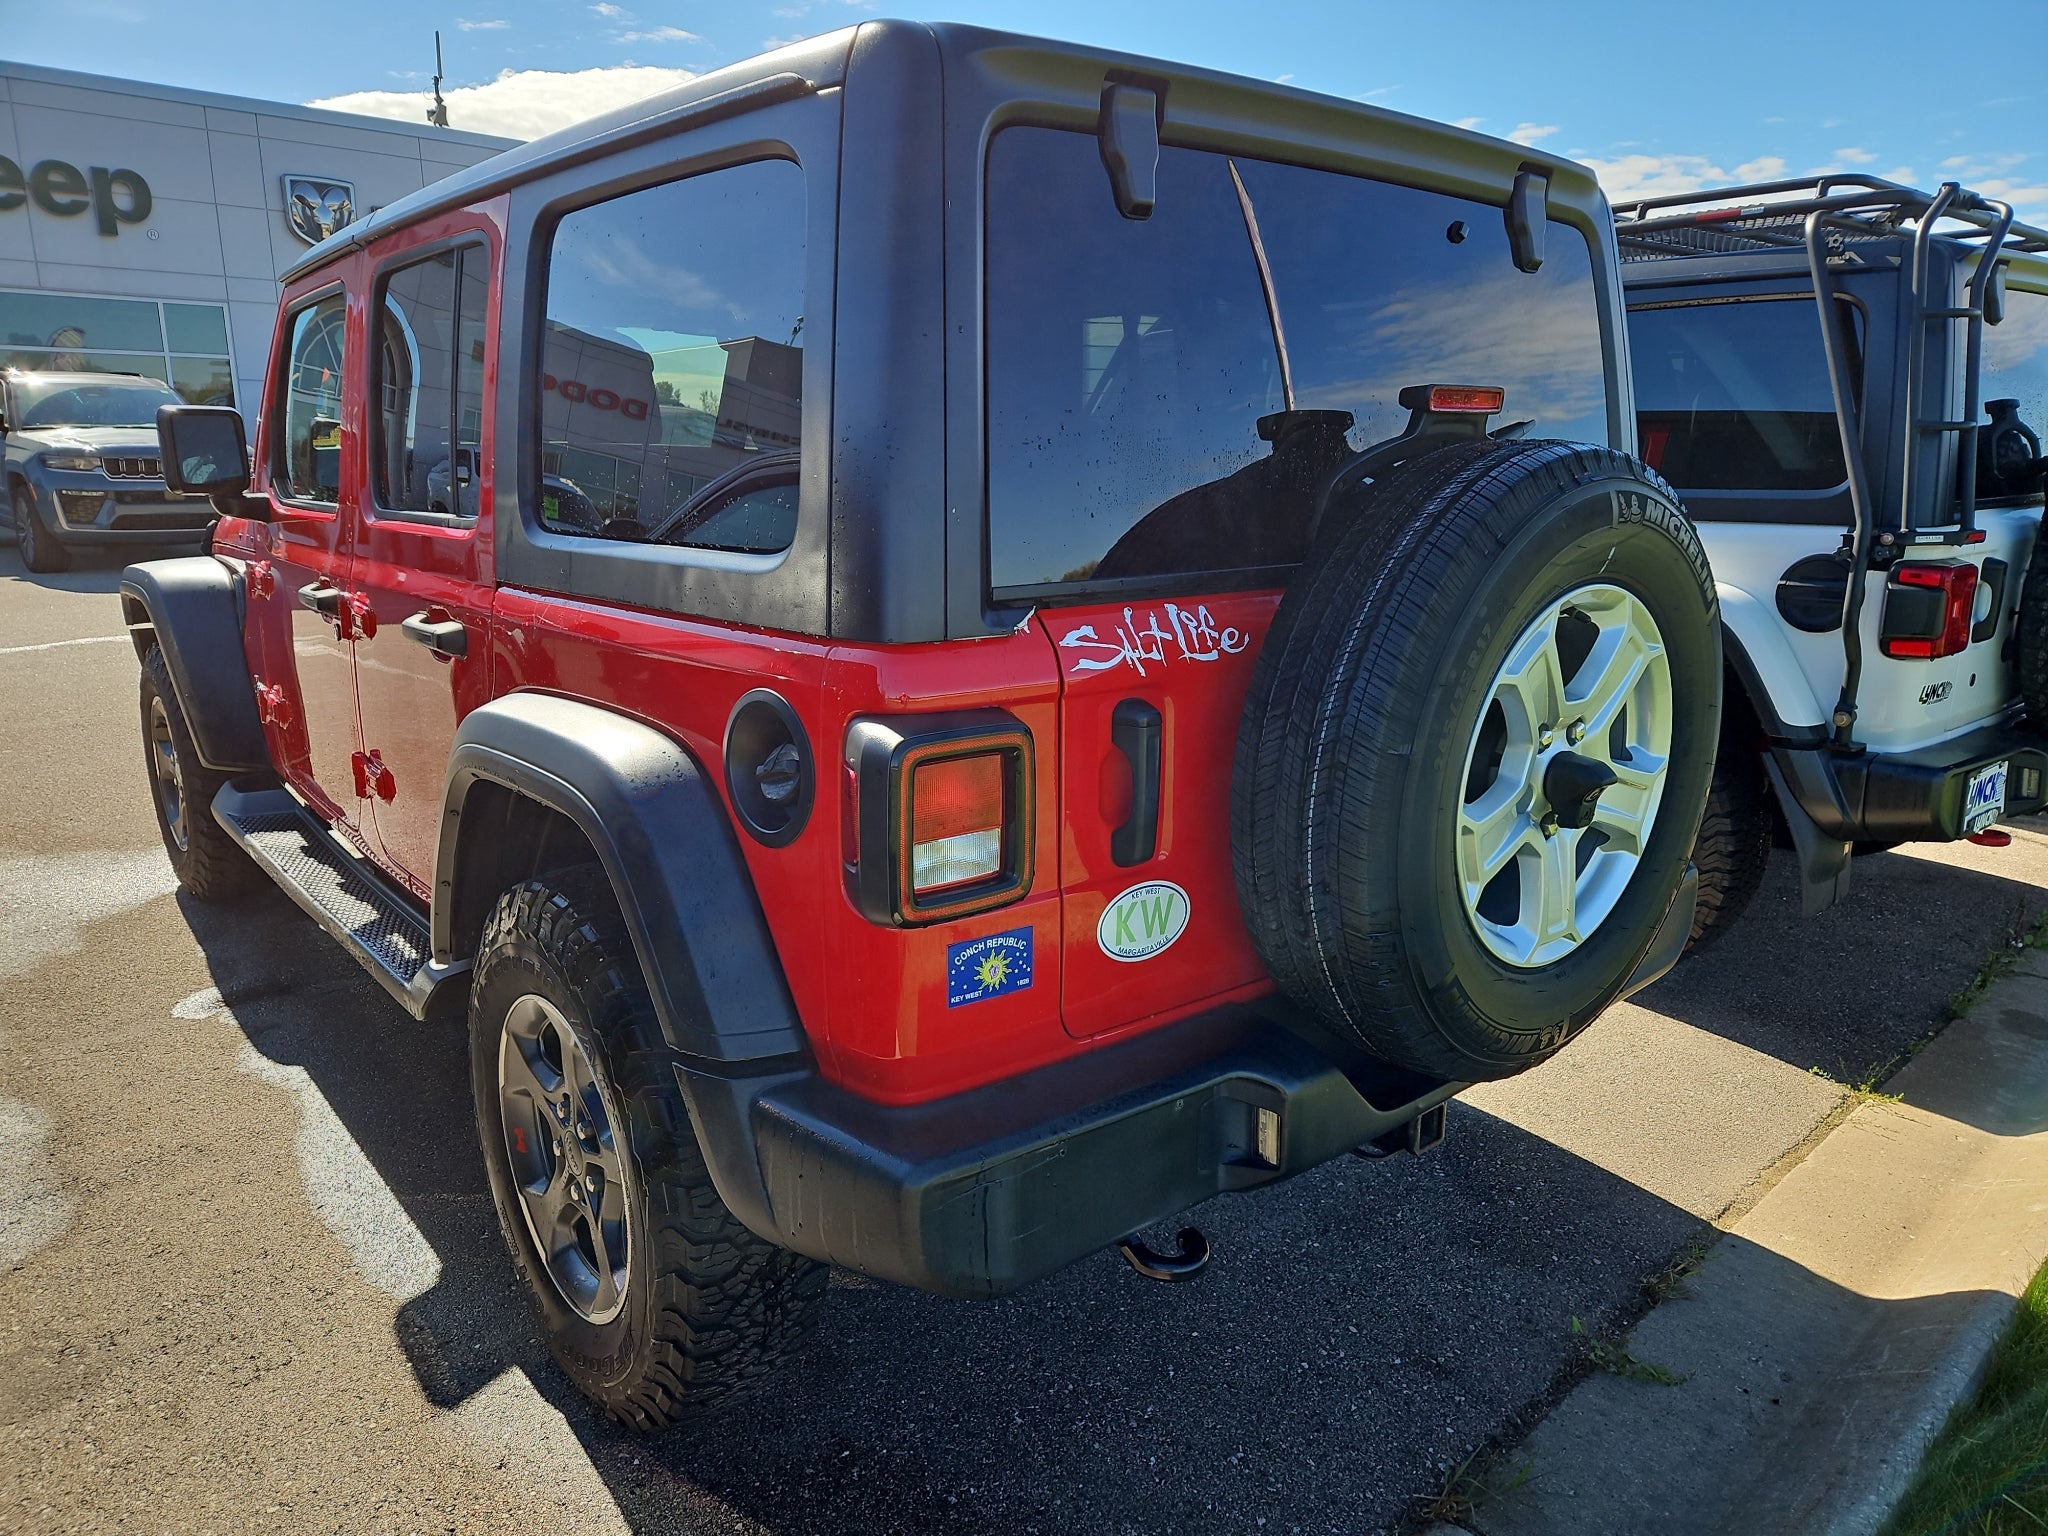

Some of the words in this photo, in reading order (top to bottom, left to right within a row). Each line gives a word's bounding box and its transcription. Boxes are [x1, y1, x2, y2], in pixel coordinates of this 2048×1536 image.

[1644, 498, 1716, 603] MICHELIN
[1131, 890, 1143, 900] KEY
[1145, 887, 1161, 896] WEST
[1116, 893, 1175, 946] KW
[954, 941, 985, 965] CONCH
[986, 936, 1027, 950] REPUBLIC
[1117, 934, 1169, 956] MARGARITAVILLE
[950, 994, 964, 1004] KEY
[964, 990, 983, 1000] WEST
